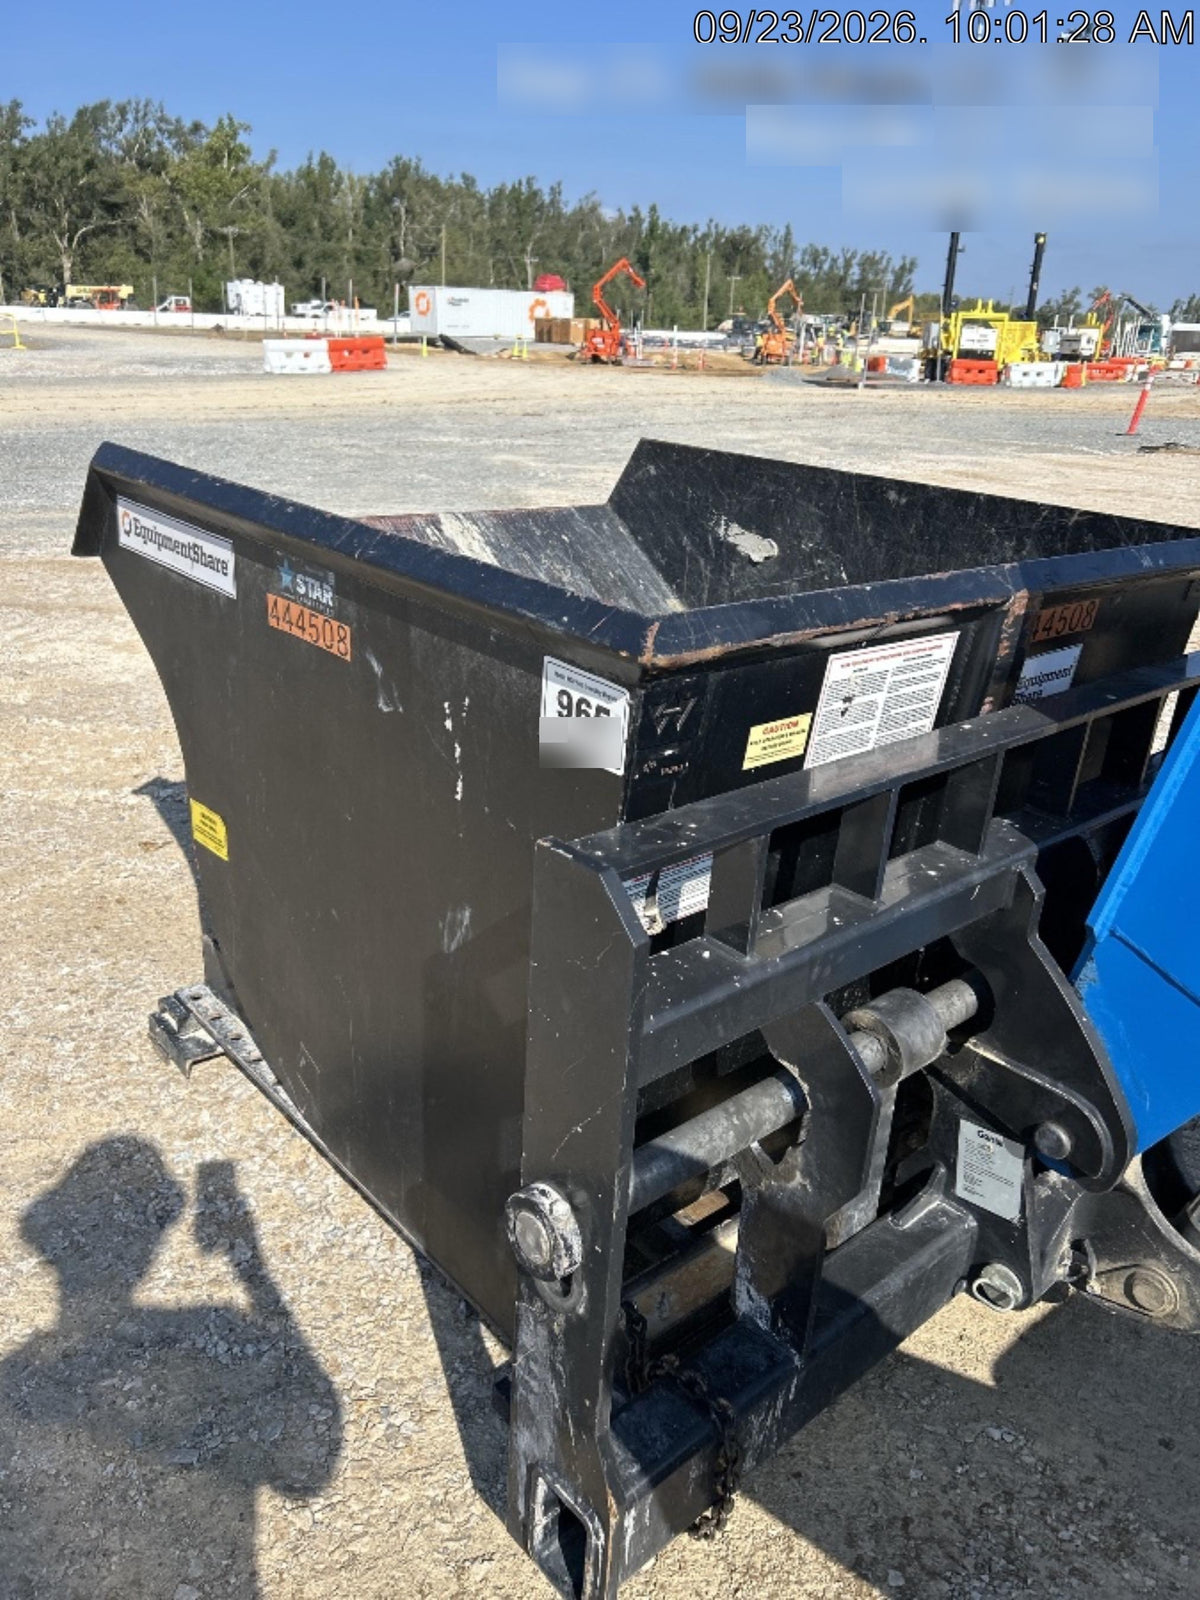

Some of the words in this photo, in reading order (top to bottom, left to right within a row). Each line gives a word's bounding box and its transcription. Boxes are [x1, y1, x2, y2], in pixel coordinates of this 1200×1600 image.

[132, 516, 230, 577] EquipmentShare
[296, 573, 333, 607] STAR
[268, 597, 349, 657] 444508
